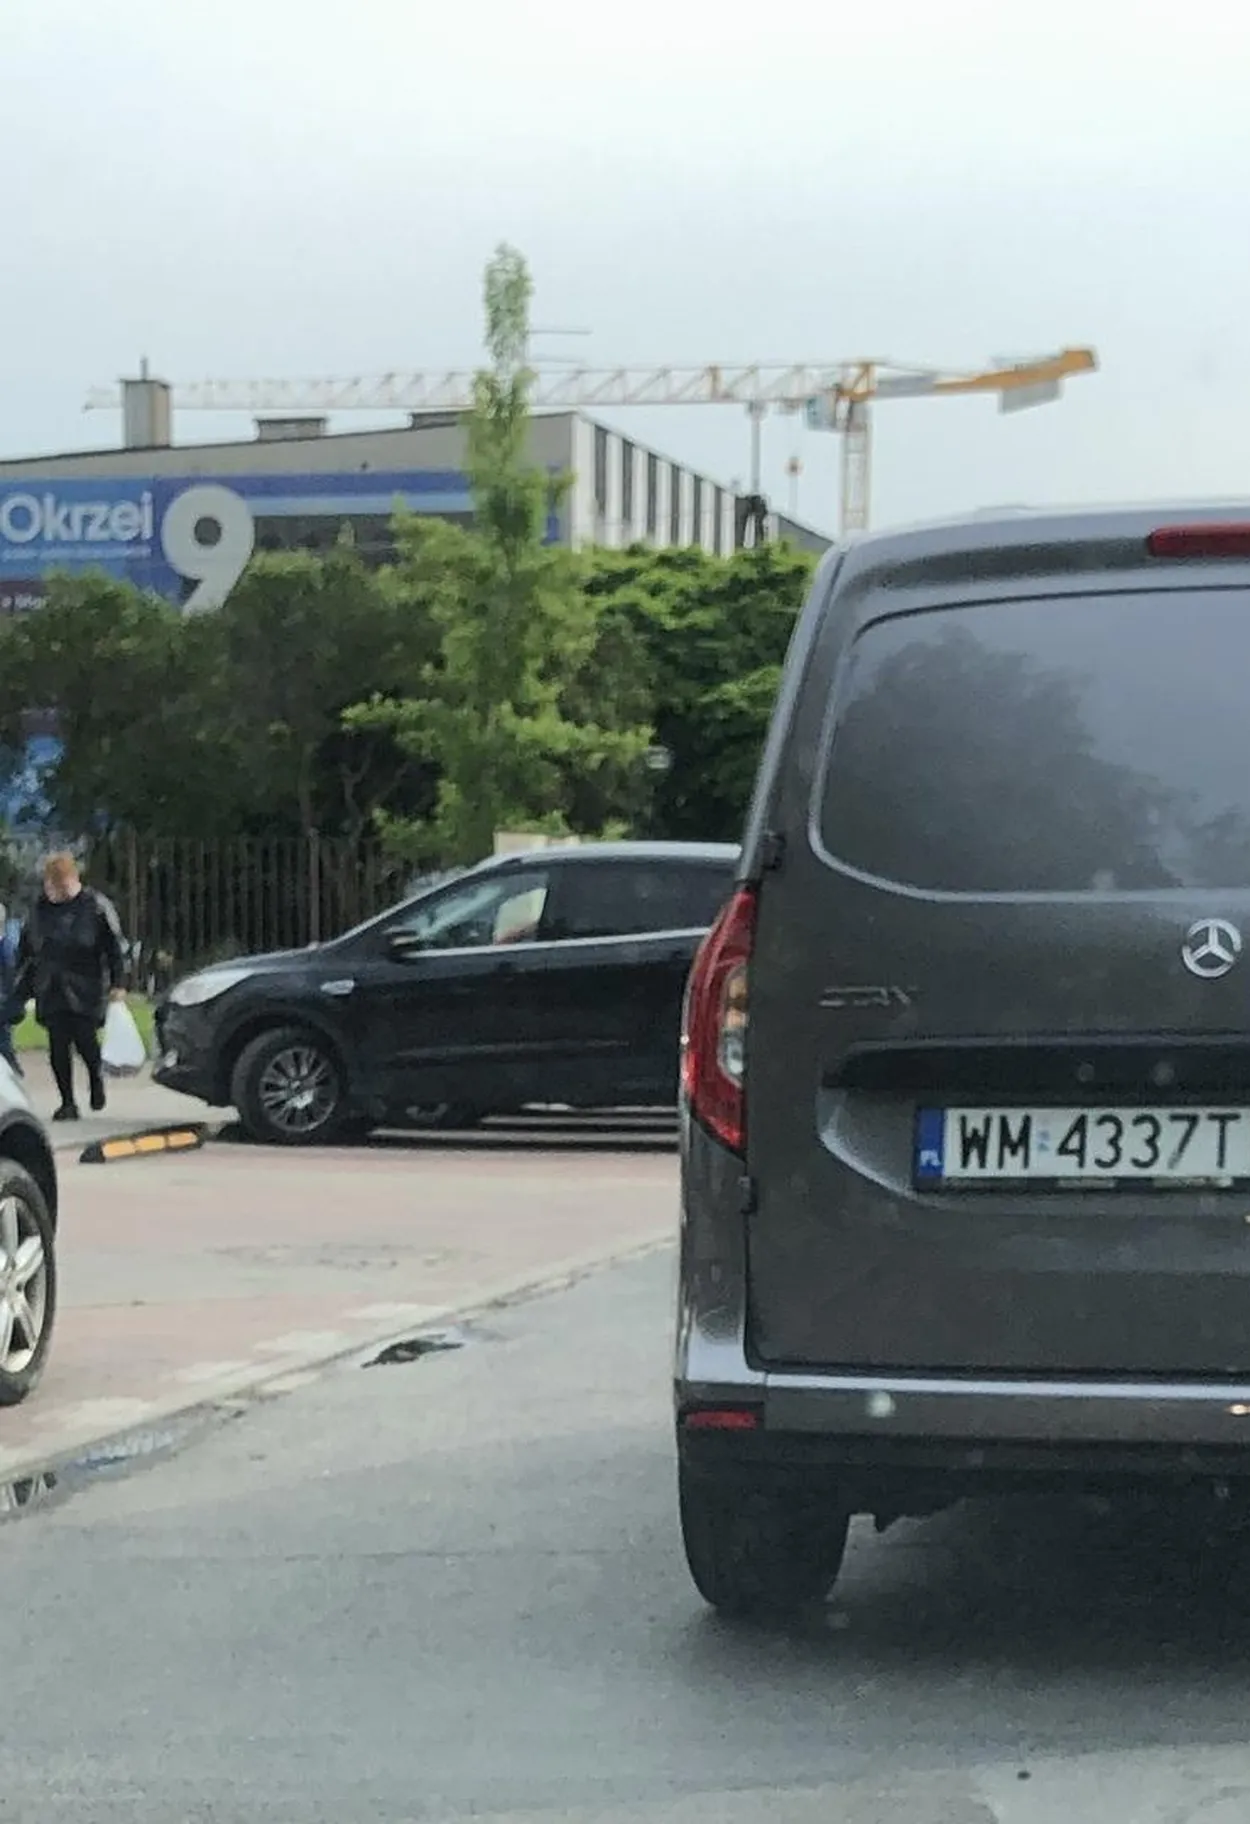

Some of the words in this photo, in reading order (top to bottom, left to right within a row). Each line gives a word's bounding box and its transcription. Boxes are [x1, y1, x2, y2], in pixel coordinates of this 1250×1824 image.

[1, 491, 153, 544] Okrzei
[160, 483, 255, 617] 9
[959, 1112, 1032, 1170] WM
[1056, 1111, 1242, 1170] 4337T
